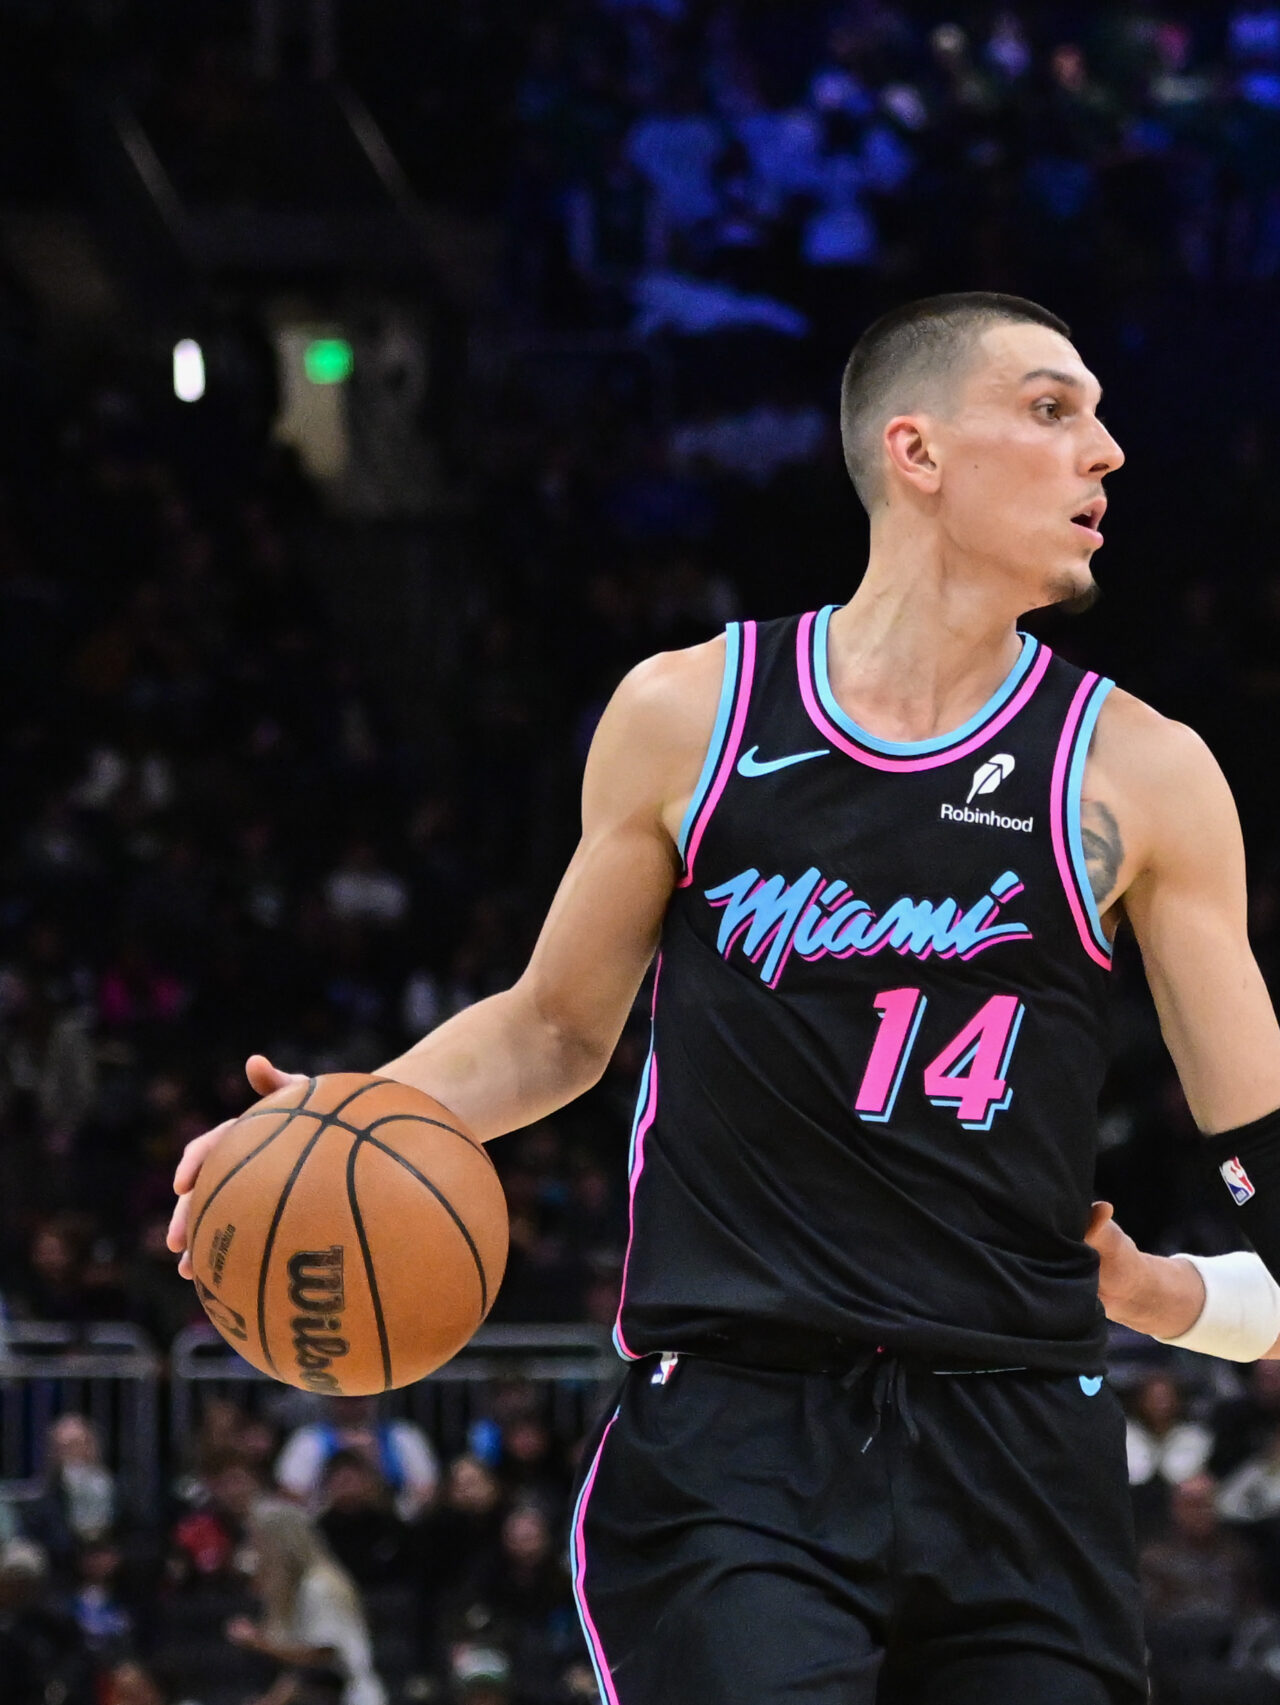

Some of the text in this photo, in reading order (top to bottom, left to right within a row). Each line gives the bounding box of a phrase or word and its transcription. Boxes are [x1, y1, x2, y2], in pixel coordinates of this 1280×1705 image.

[940, 804, 1034, 833] Robinhood
[704, 866, 1033, 990] Miami
[854, 987, 1026, 1131] 14
[286, 1245, 351, 1394] Wilso
